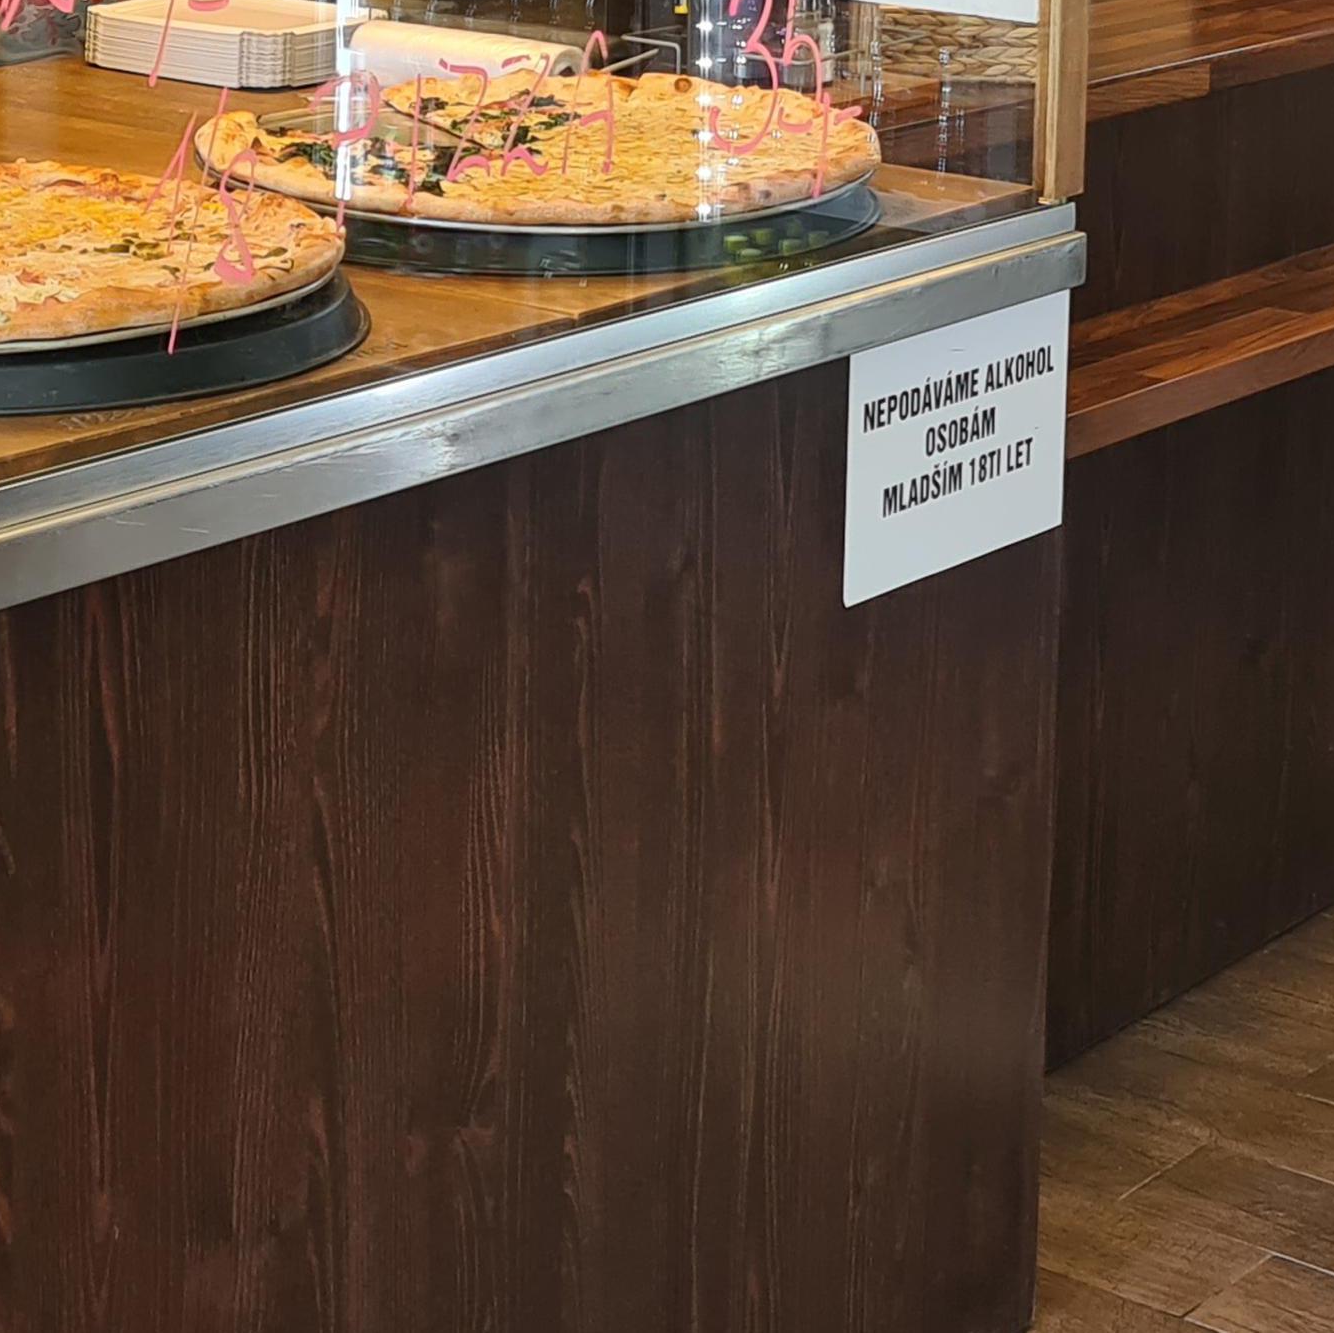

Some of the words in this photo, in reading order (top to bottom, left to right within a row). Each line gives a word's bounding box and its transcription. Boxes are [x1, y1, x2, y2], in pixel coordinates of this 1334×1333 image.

[863, 368, 980, 434] NEPODÁVÁME
[984, 345, 1055, 394] ALKOHOL
[925, 406, 997, 457] OSOBÁM
[882, 462, 964, 519] MLADŠÍM
[969, 448, 1002, 486] 18TI
[1006, 437, 1034, 473] LET
